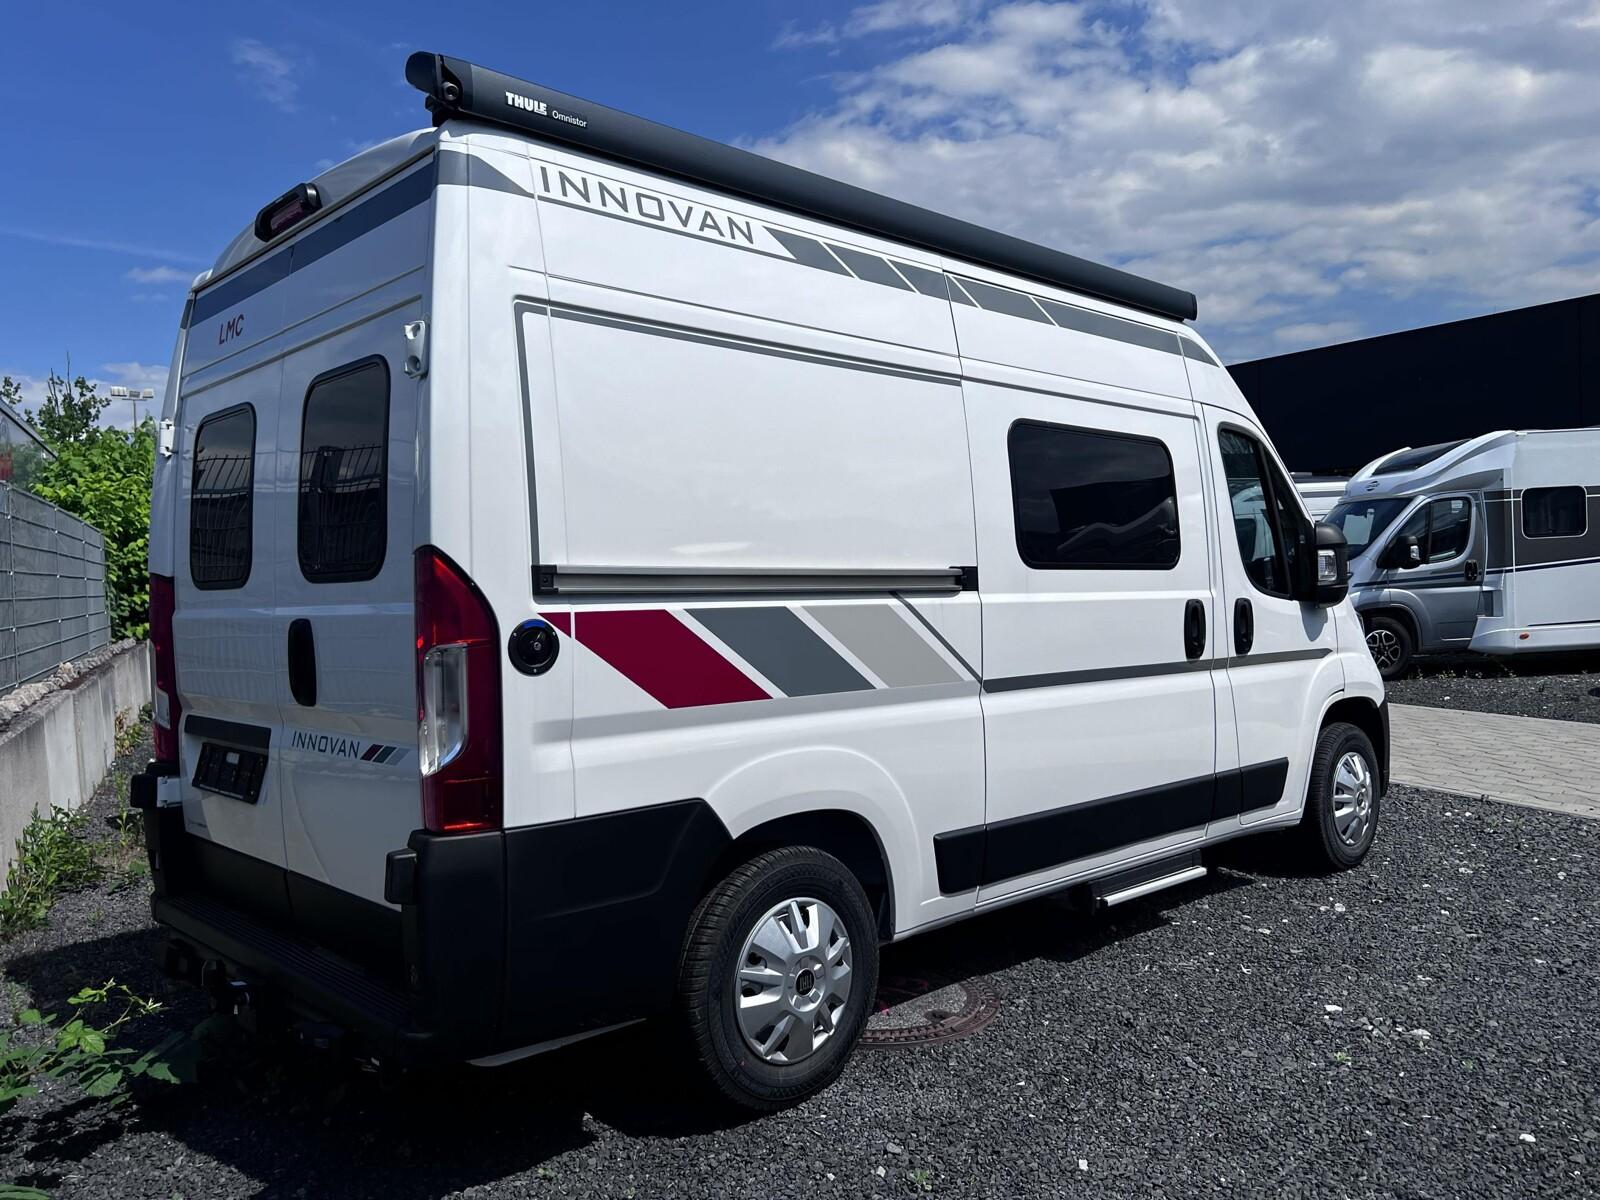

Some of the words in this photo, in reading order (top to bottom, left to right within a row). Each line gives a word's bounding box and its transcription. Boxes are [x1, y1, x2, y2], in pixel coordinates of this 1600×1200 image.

[505, 91, 548, 116] THULE
[552, 110, 588, 128] Omnistor
[540, 166, 754, 244] INNOVAN
[219, 313, 245, 345] LMC
[291, 730, 361, 759] INNOVAN
